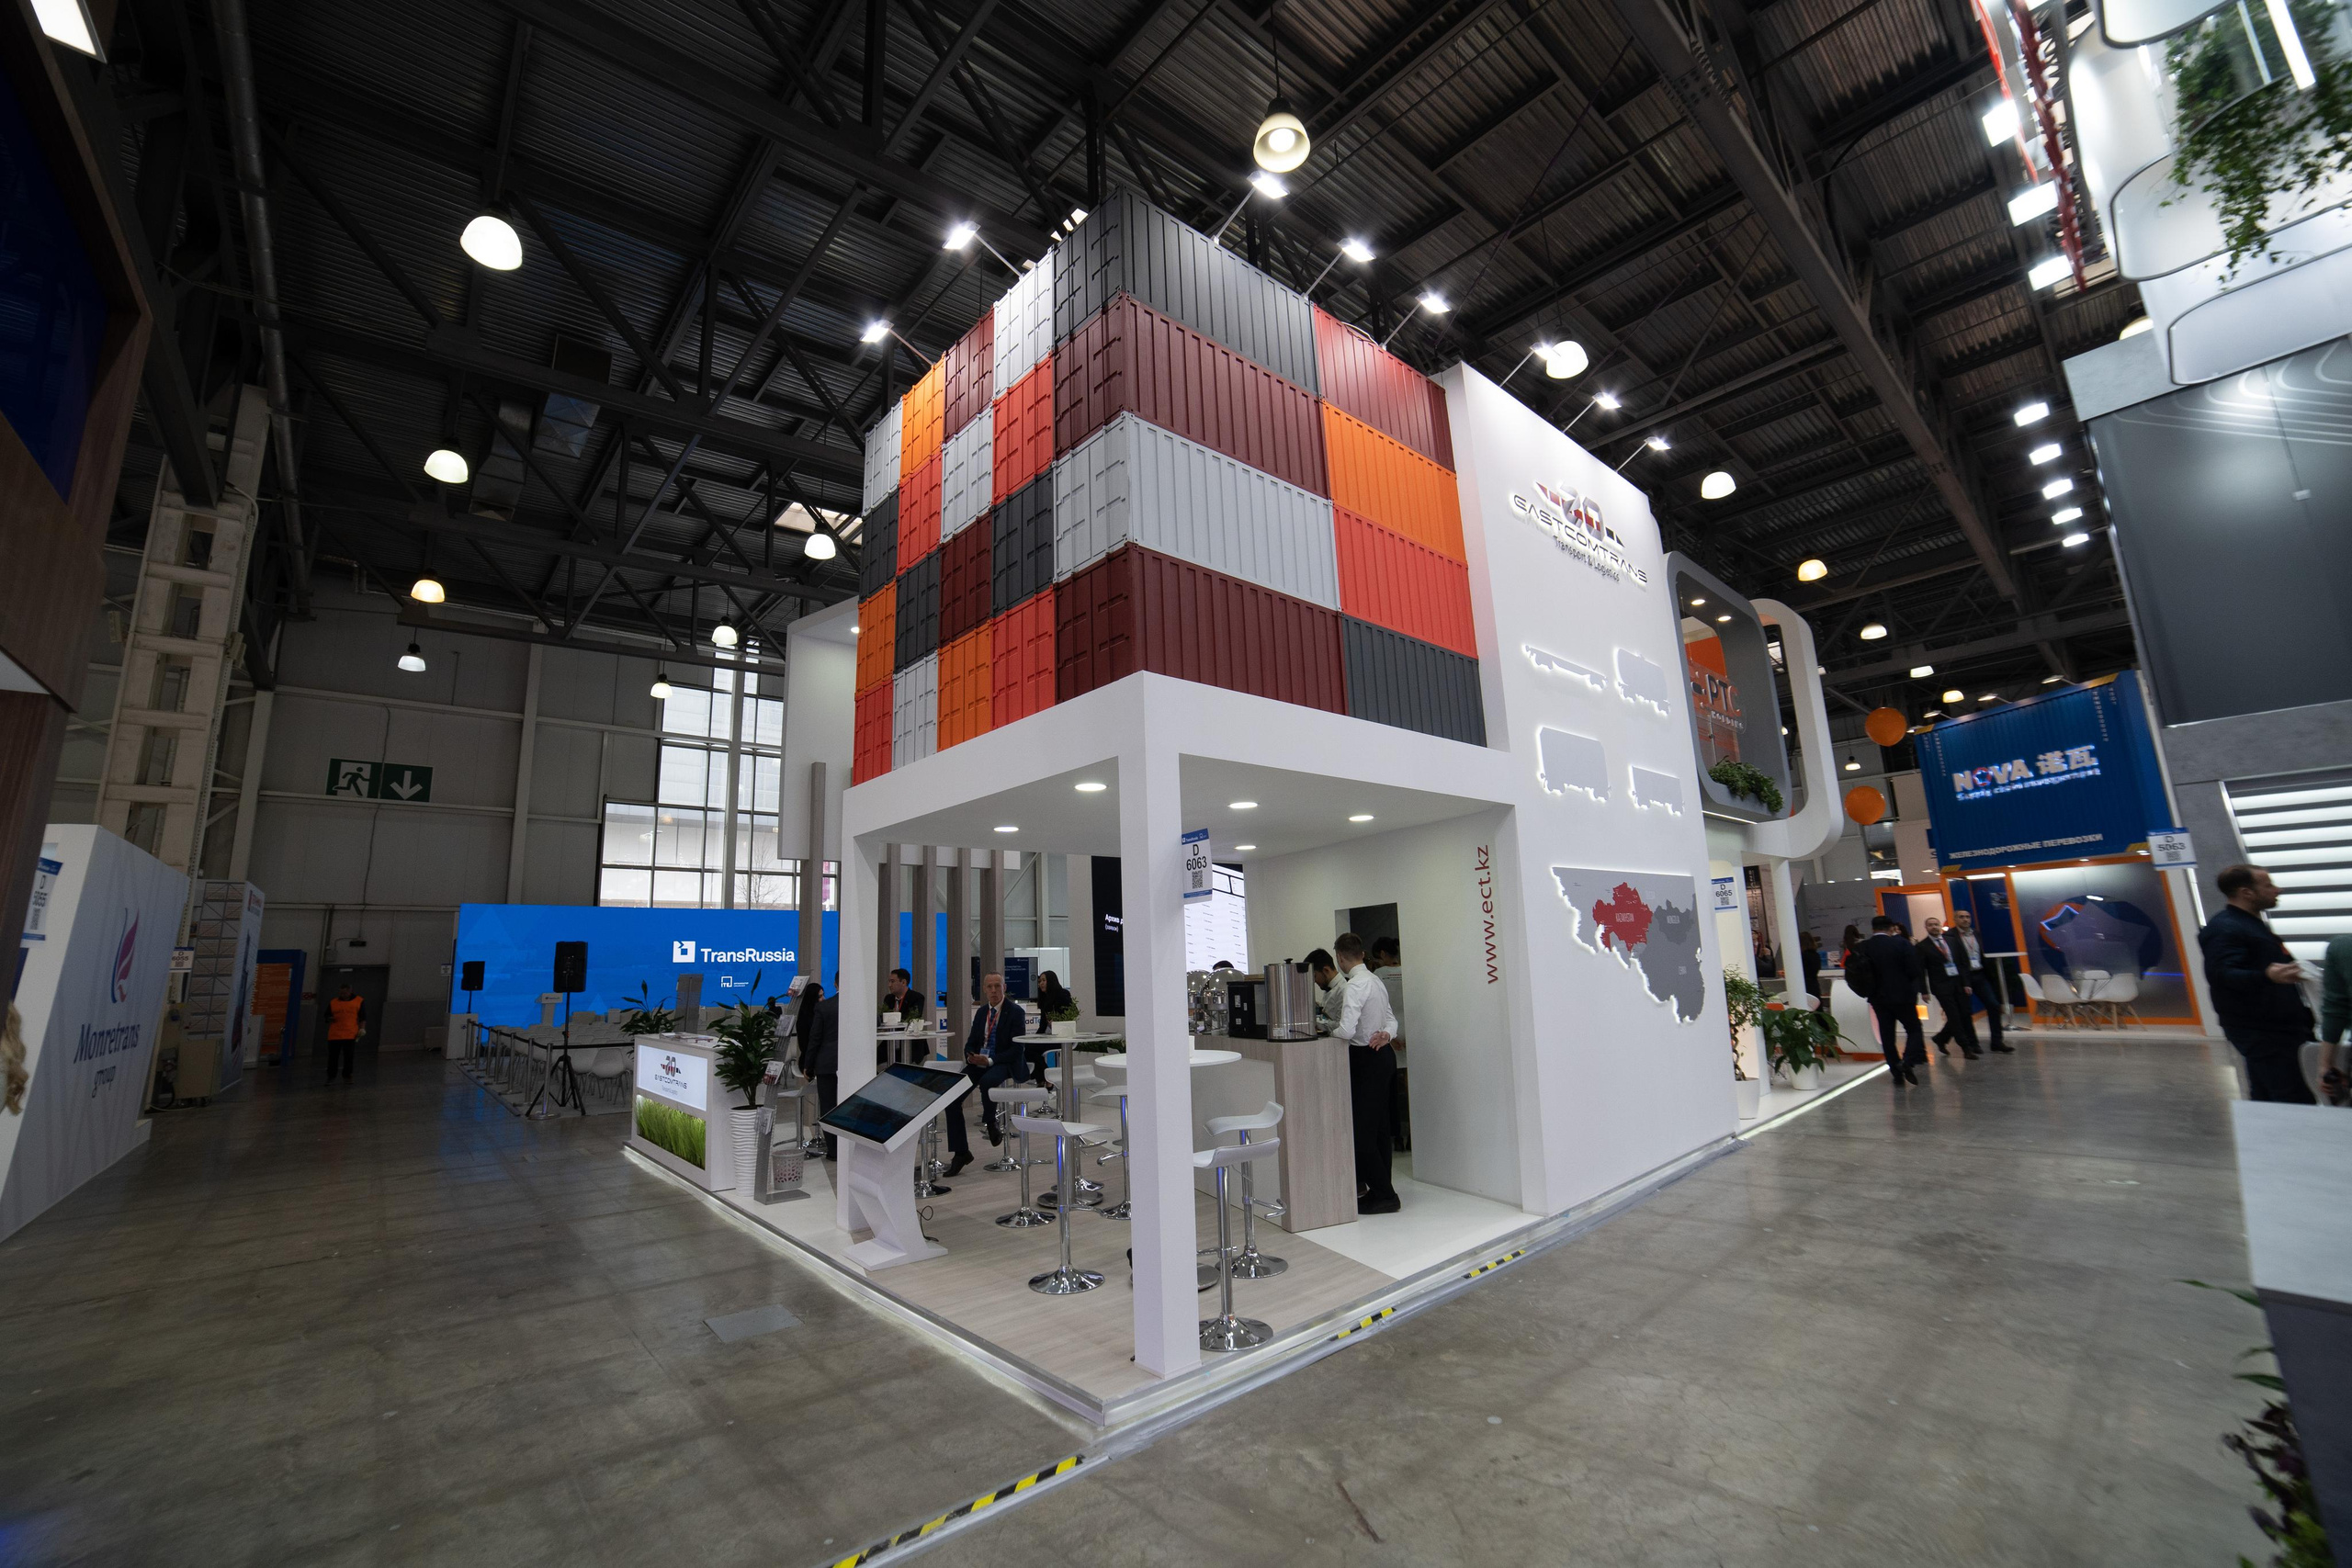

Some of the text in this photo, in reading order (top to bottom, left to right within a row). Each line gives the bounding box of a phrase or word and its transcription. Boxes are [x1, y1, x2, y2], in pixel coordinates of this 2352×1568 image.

[1513, 494, 1648, 583] EASTCOMTRANS
[1553, 536, 1587, 564] Transport
[1594, 558, 1620, 582] Logistics
[1952, 759, 2034, 793] NOVA
[1193, 844, 1200, 857] D
[1949, 840, 2041, 860] ЖЕЛЕЗНОДОРОЖНЫЕ
[2042, 833, 2104, 848] ПЕРЕВОЗКИ
[2165, 835, 2174, 843] D
[1186, 856, 1207, 871] 6063
[1715, 889, 1733, 897] 6065
[1475, 844, 1498, 984] www.ect.kz
[700, 947, 796, 963] TransRussia
[74, 1021, 141, 1064] Monretrans
[92, 1066, 117, 1098] group
